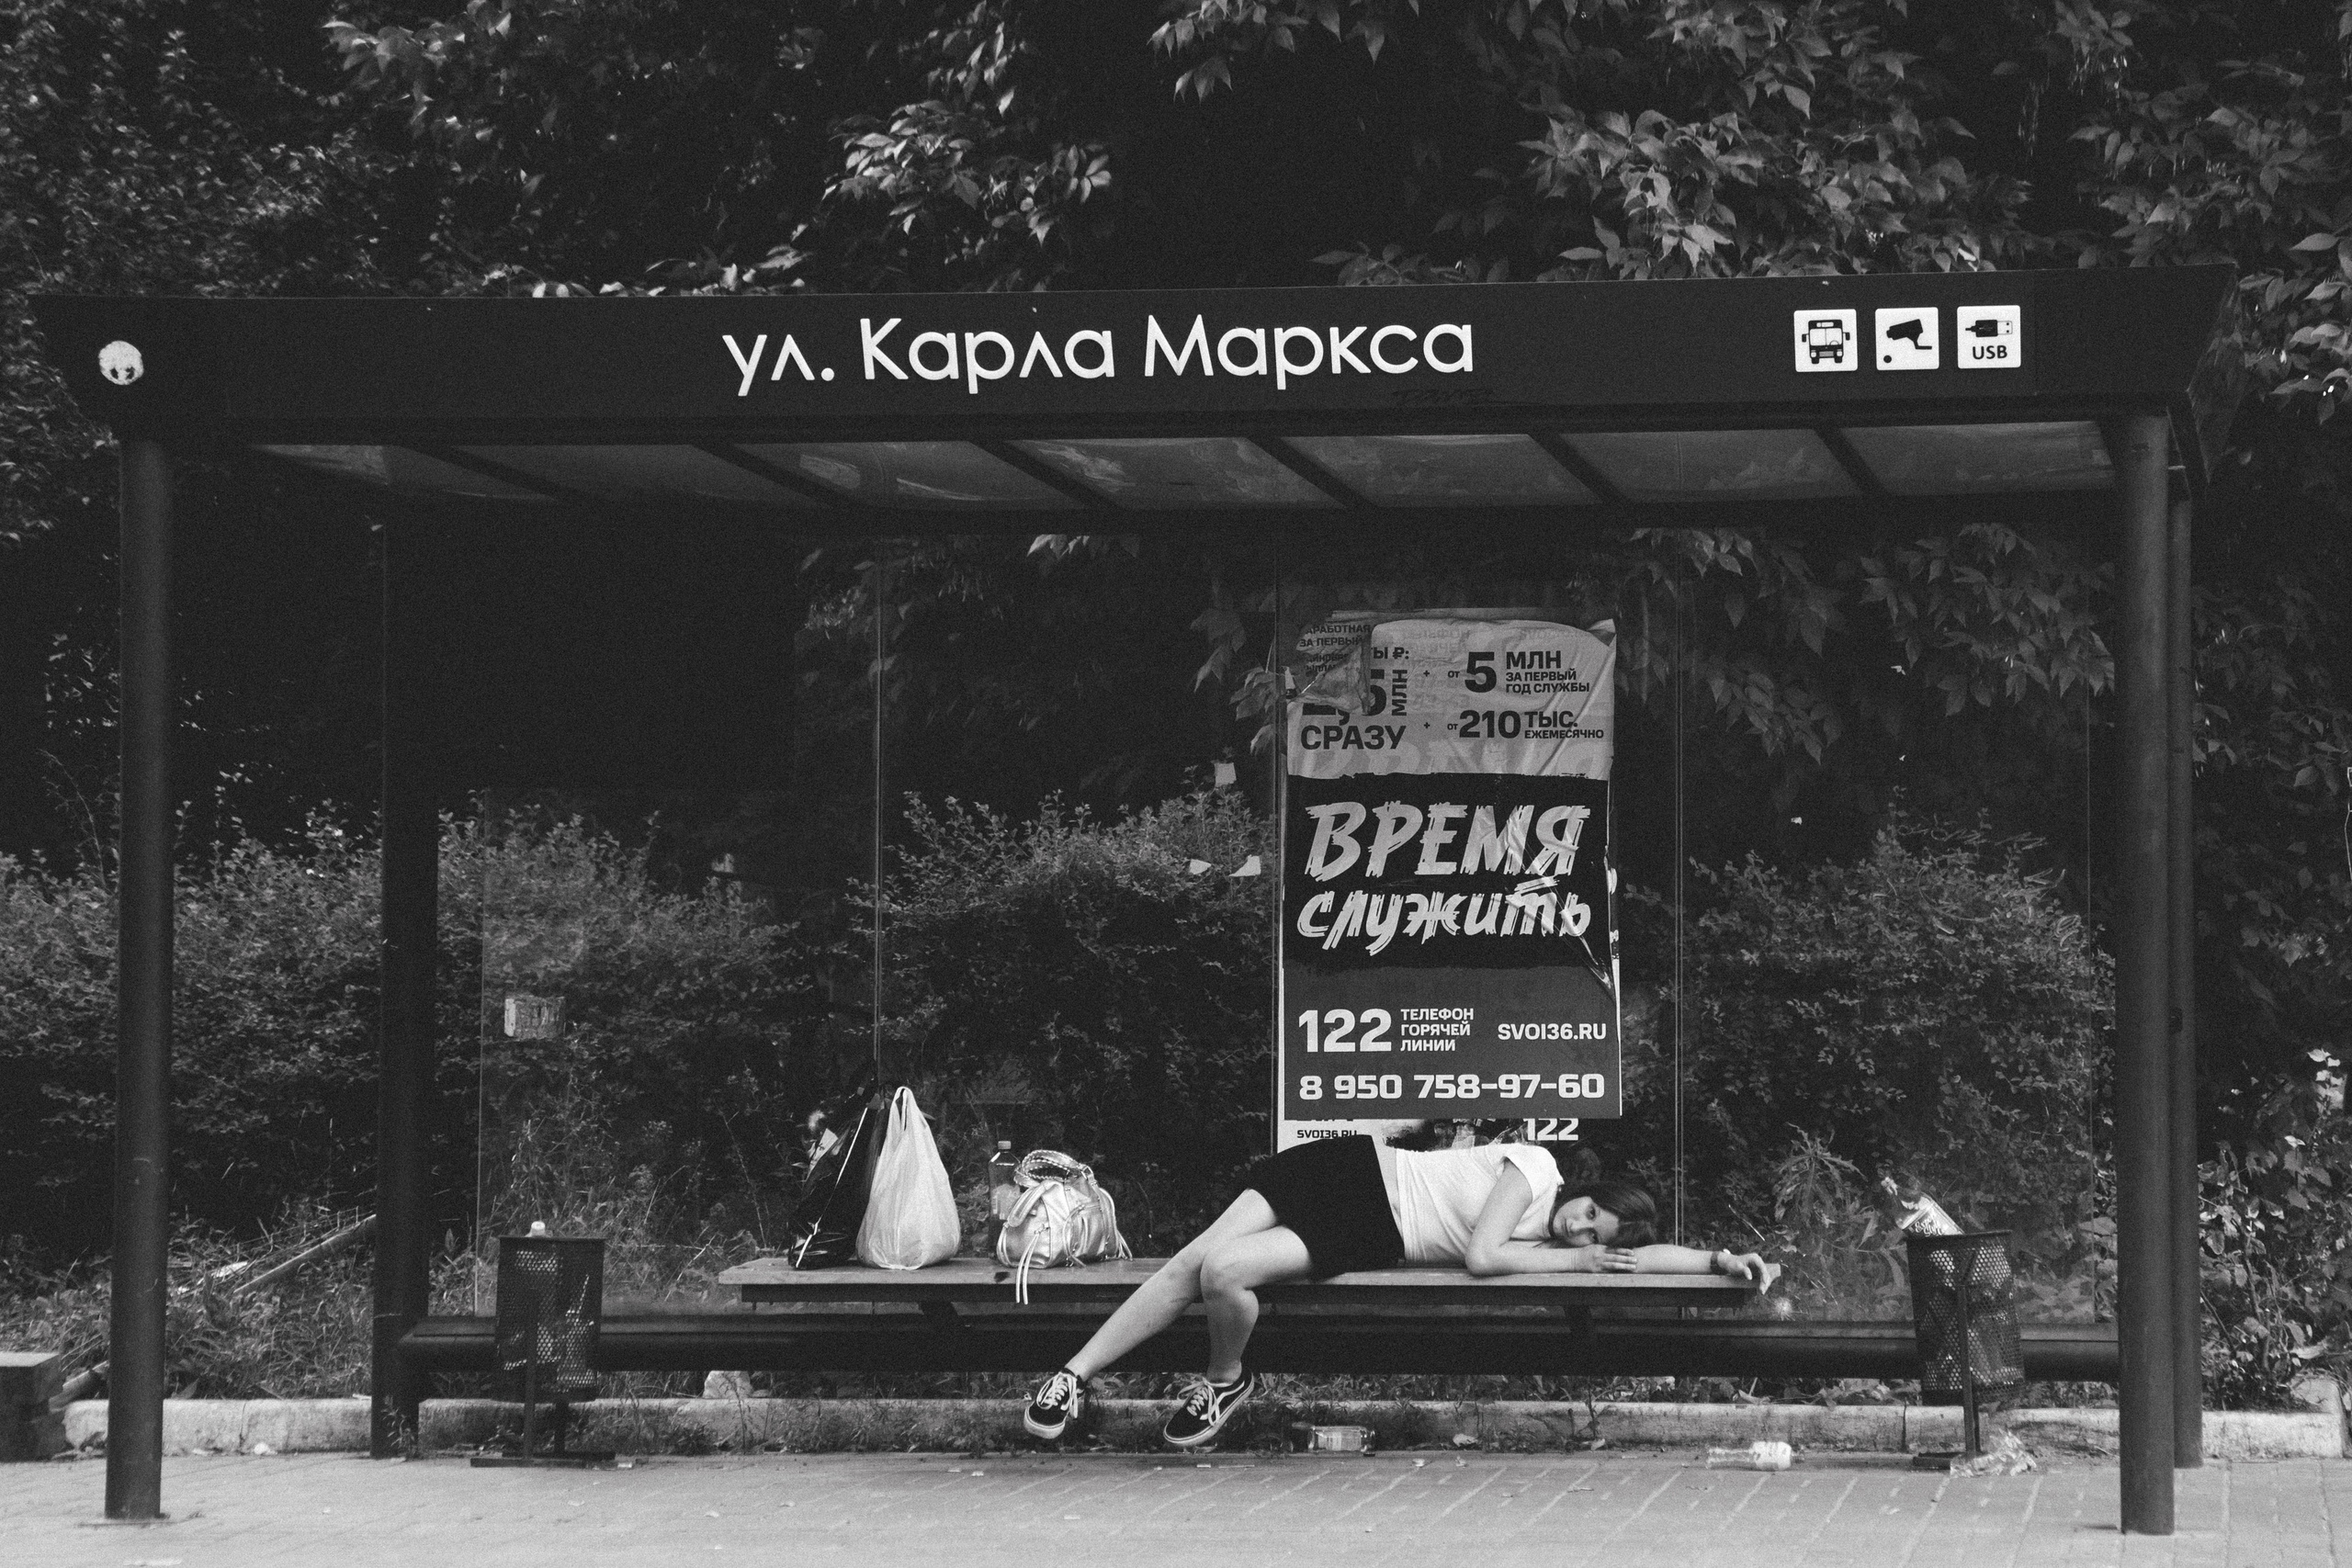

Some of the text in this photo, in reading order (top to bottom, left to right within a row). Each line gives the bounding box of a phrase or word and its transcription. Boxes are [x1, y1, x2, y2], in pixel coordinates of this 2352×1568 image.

[722, 314, 1474, 396] ул. Карла Маркса
[1973, 345, 2007, 360] USB
[1464, 651, 1497, 693] 5
[1506, 650, 1561, 670] МЛН
[1506, 668, 1577, 682] ЗА ПЕРВЫЙ
[1391, 669, 1408, 716] МЛН
[1506, 682, 1589, 694] ГОД СЛУЖБЫ
[1459, 710, 1521, 739] 210
[1524, 711, 1577, 728] ТЫС.
[1524, 729, 1604, 739] ЕЖЕМЕСЯЧНО
[1300, 725, 1407, 750] СРАЗУ
[1305, 800, 1591, 882] ВРЕМЯ
[1401, 1008, 1474, 1021] ТЕЛЕФОН
[1298, 1009, 1392, 1052] 122
[1401, 1021, 1471, 1036] ГОРЯЧЕЙ
[1498, 1022, 1607, 1040] SVOI36.RU
[1400, 1039, 1456, 1052] ЛИНИИ
[1299, 1075, 1323, 1100] 8
[1334, 1074, 1402, 1099] 950
[1296, 1130, 1357, 1138] SVOI36RU
[1523, 1118, 1578, 1141] 122
